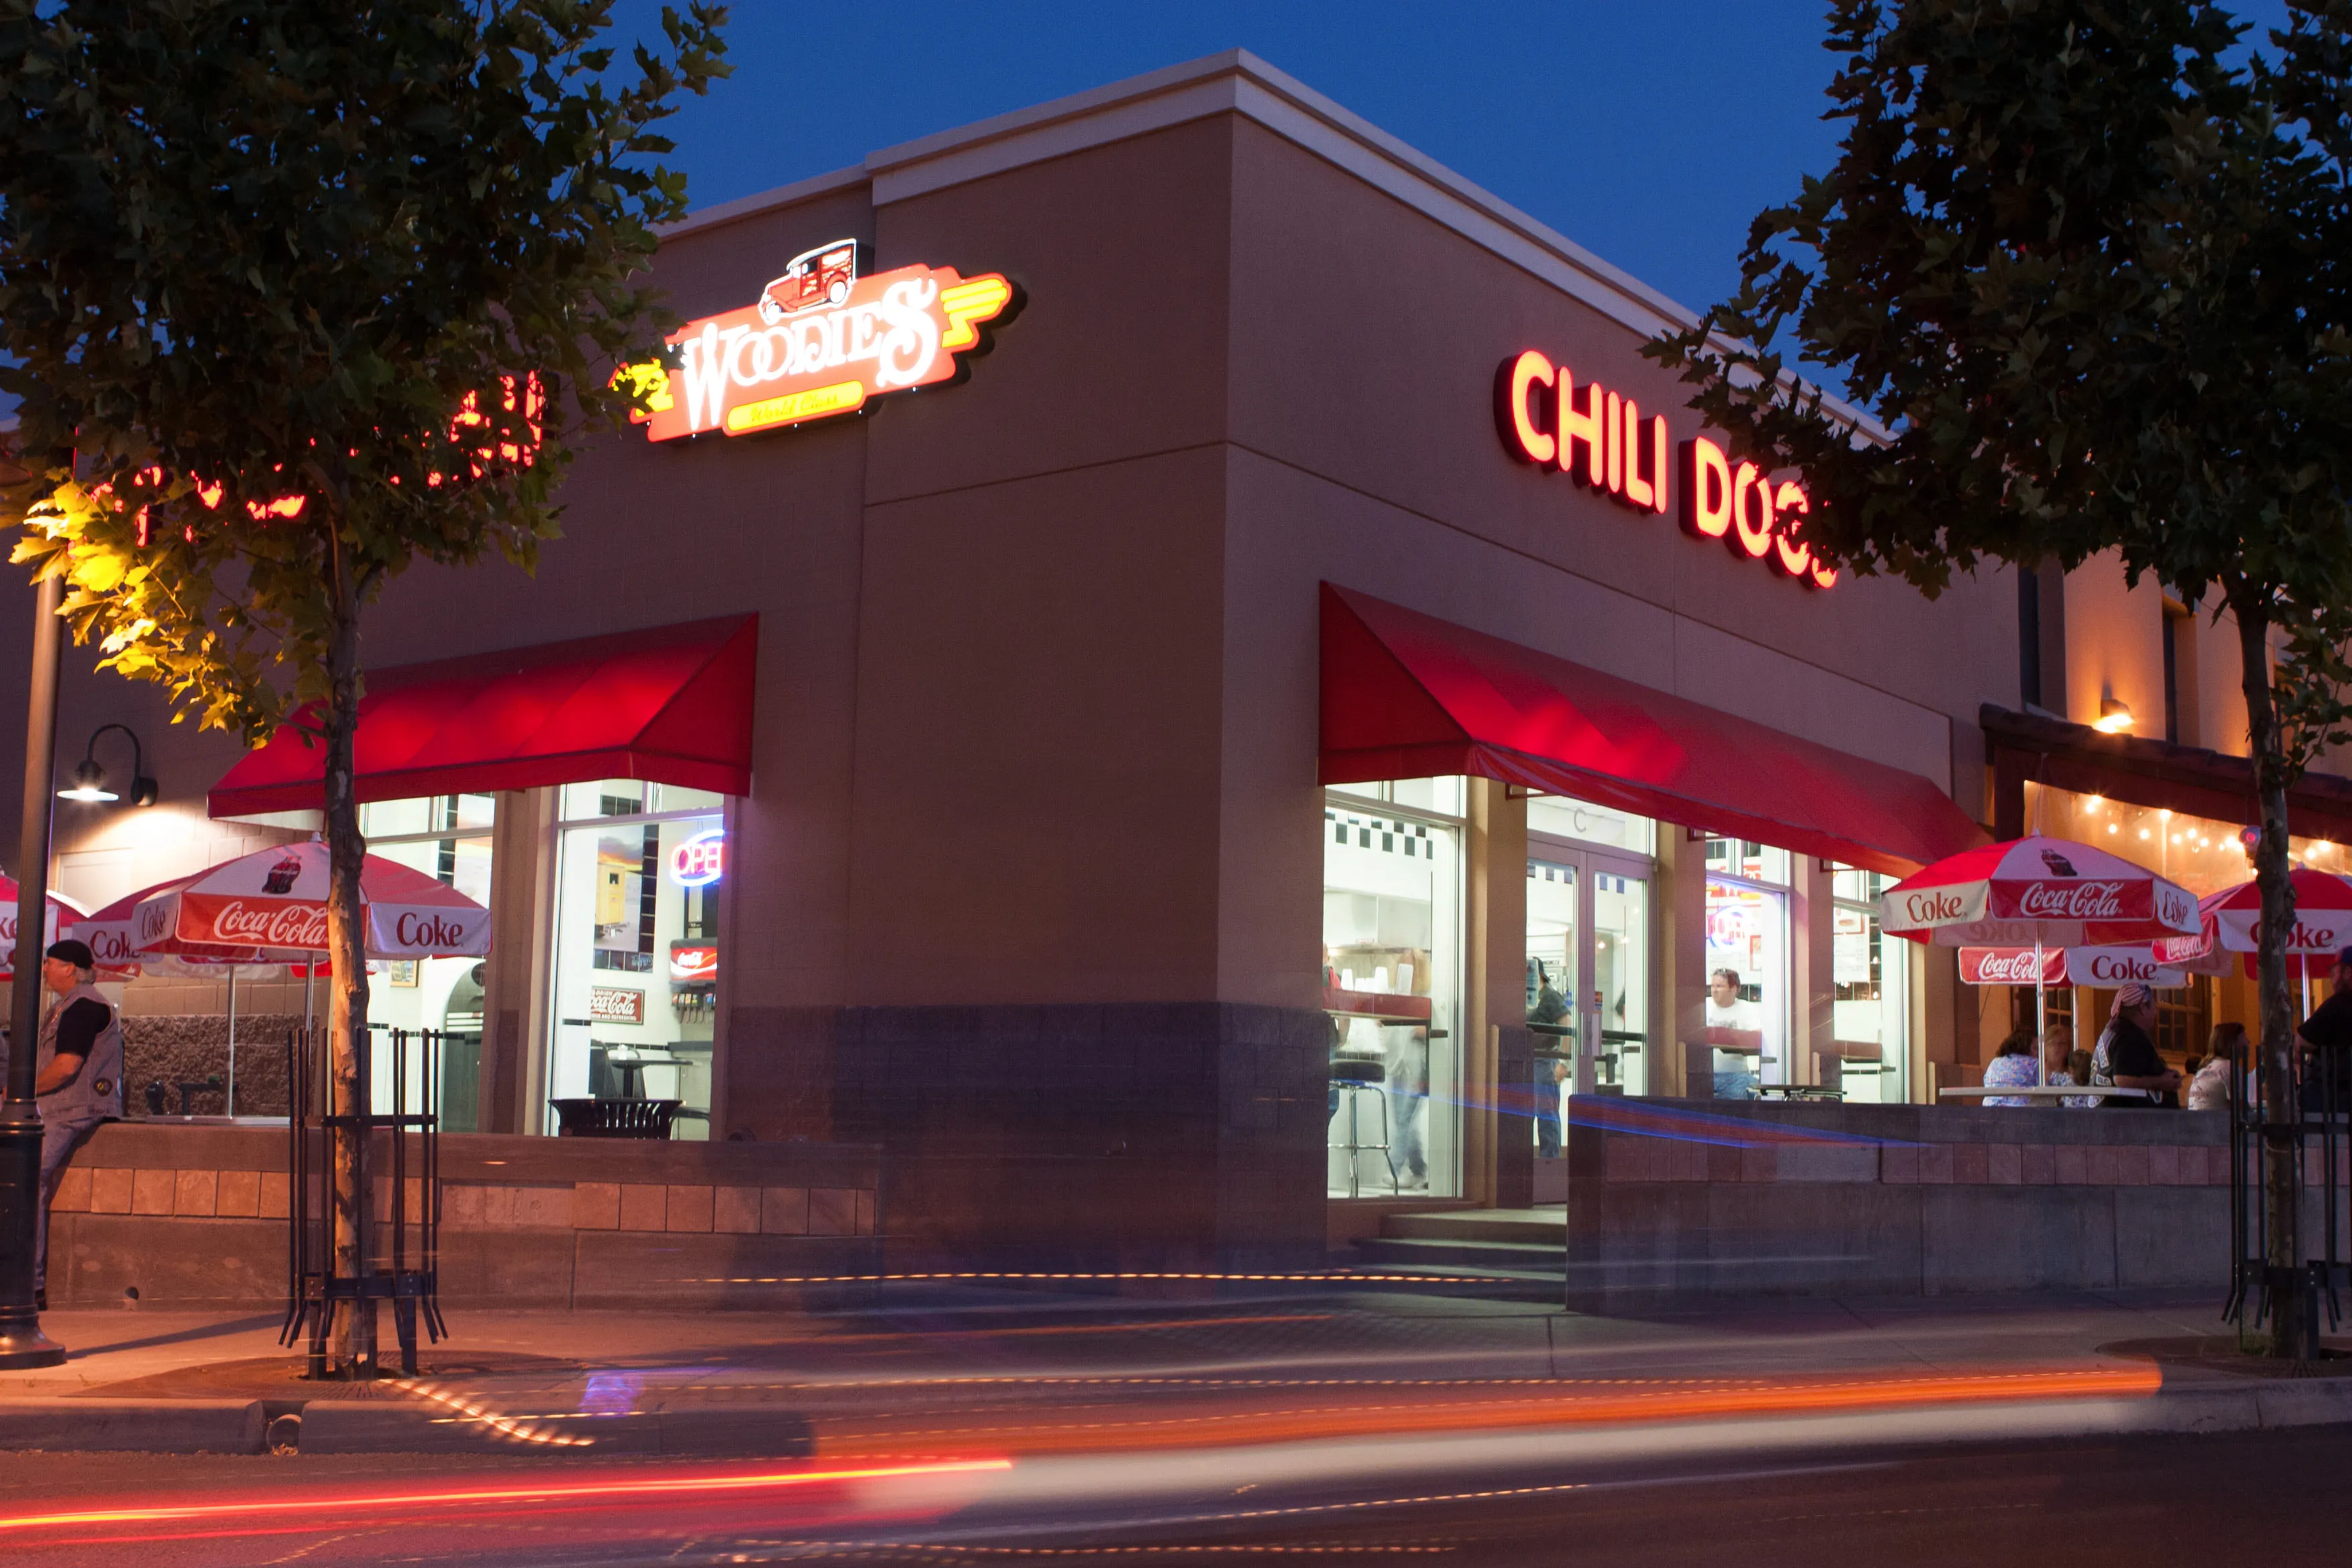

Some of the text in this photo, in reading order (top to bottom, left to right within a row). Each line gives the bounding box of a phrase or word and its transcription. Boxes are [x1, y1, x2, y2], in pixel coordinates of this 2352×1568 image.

[750, 393, 838, 422] World Class
[1512, 349, 1668, 515] CHILI
[671, 842, 724, 875] OPE
[1906, 891, 1964, 924] Coke
[2020, 882, 2124, 917] Coca-Cola
[2163, 891, 2188, 926] Coke
[141, 903, 166, 940] Coke
[213, 901, 328, 945] Coca-Cola
[396, 912, 463, 947] Coke
[2091, 955, 2157, 981] Coke
